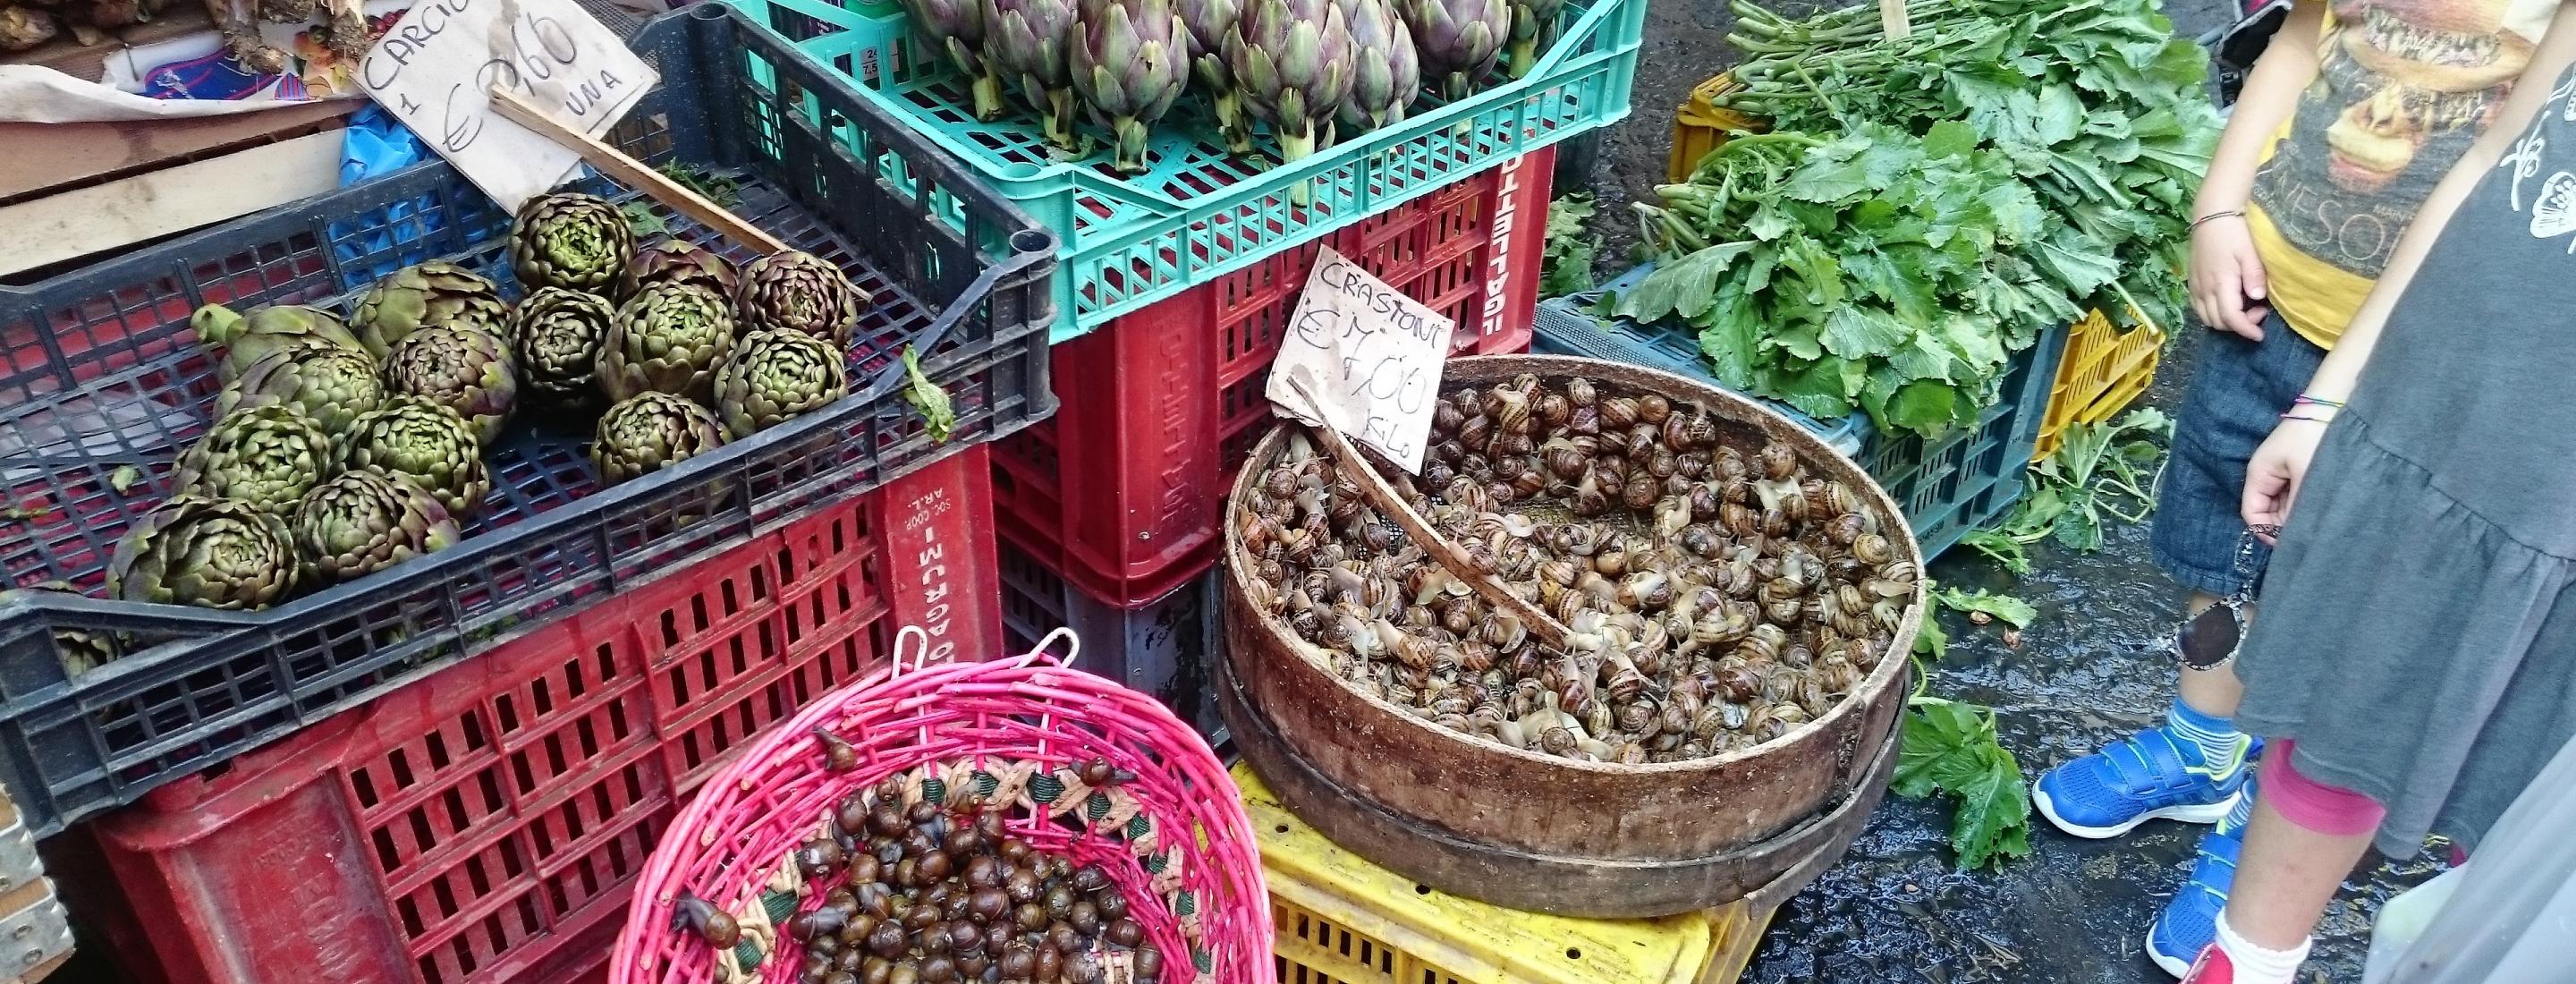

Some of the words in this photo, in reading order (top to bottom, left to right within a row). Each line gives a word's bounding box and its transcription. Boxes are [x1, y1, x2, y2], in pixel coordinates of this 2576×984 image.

[564, 69, 623, 116] UNA
[1297, 310, 1341, 350] €
[919, 526, 951, 638] AGRUMI
